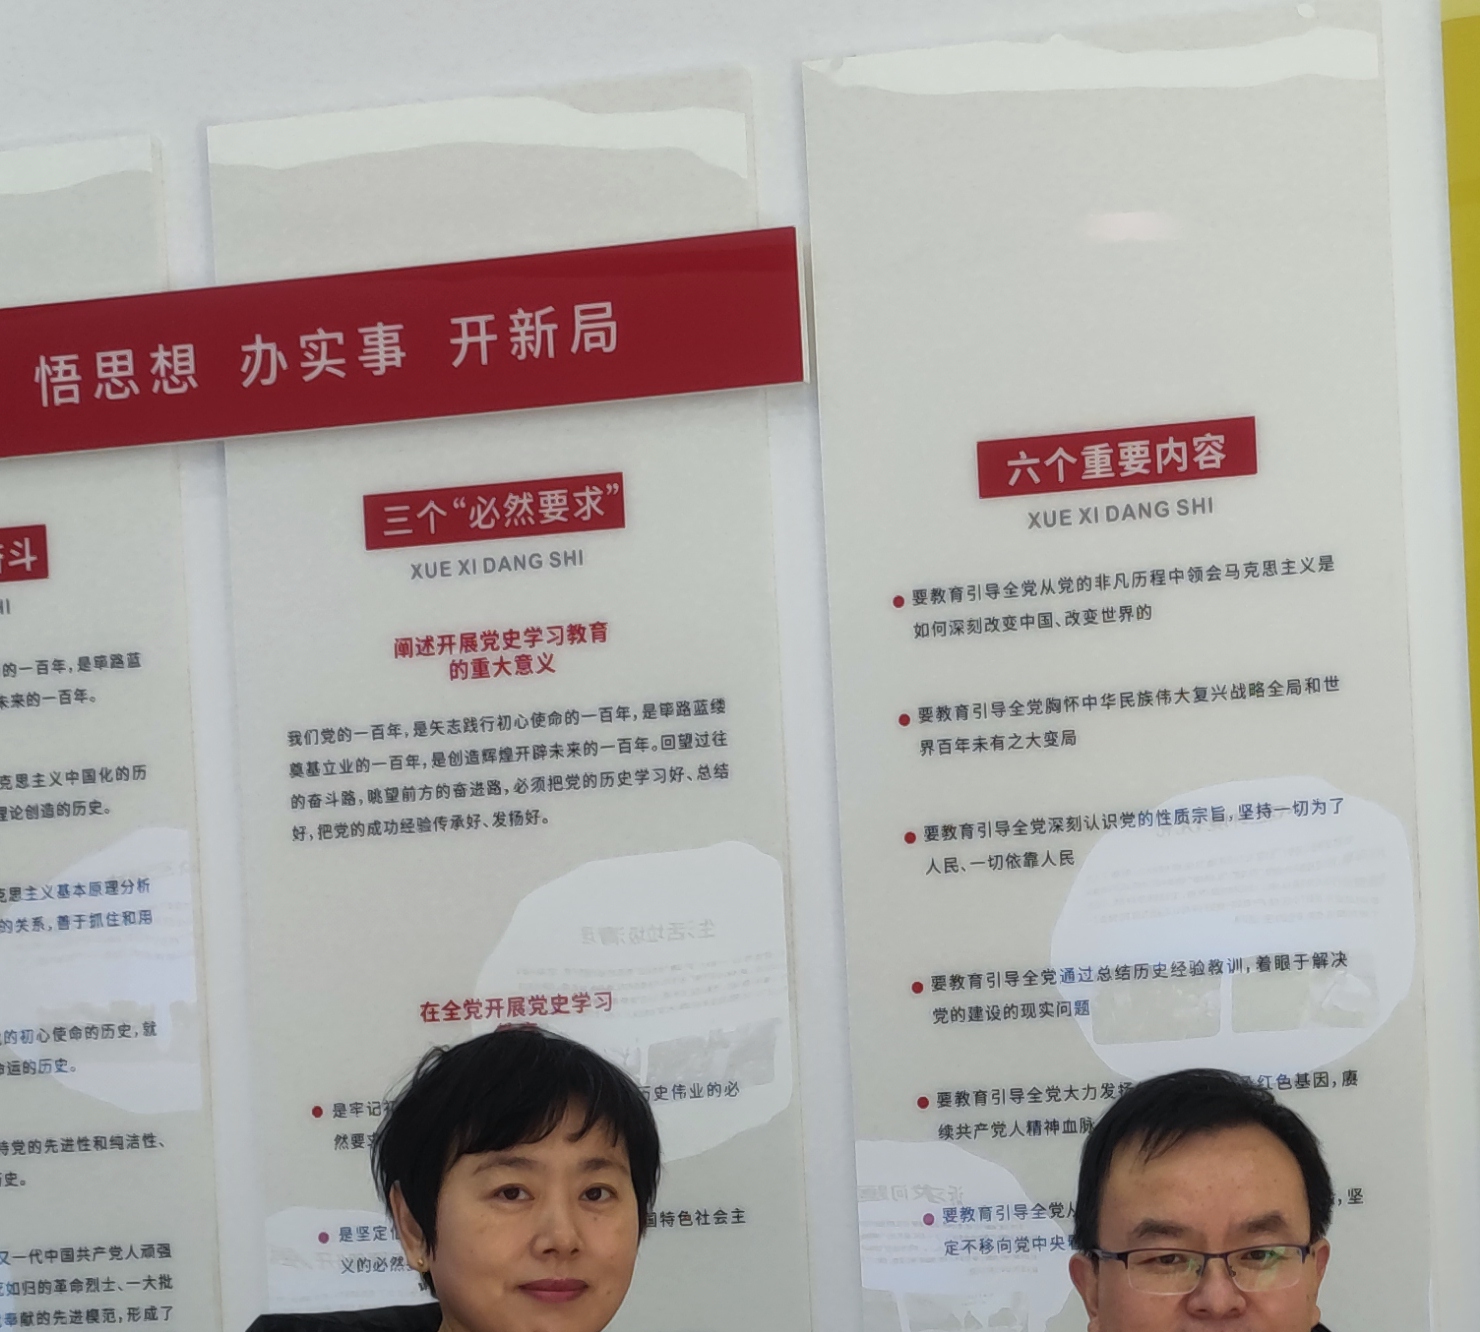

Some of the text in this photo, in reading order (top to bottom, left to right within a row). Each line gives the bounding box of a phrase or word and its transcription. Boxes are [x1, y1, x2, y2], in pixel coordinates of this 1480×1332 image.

[34, 343, 200, 405] 悟思想
[239, 319, 409, 386] 办实事
[449, 298, 622, 370] 开新局
[1007, 433, 1226, 486] 六个重要内容
[383, 482, 620, 535] 三个“必然要求”
[1028, 497, 1213, 529] XUE XI DANG SHI
[410, 549, 584, 580] XUE XI DANG SHI
[912, 555, 1334, 606] 要教育引导全党从党的非凡历程中领会马克思主义是
[914, 604, 1152, 639] 如何深刻改变中国、改变世界的
[393, 621, 608, 659] 阐述开展党史学习教育
[449, 652, 556, 681] 的重大意义
[918, 675, 1339, 724] 要教育引导全党胸怀中华民族伟大复兴战略全局和世
[920, 730, 1076, 756] 界百年未有之大变局
[924, 798, 1343, 842] 要教育引导全党深刻认识党的性质宗旨，坚持一切为了
[926, 850, 1074, 875] 人民、一切依靠人民
[420, 992, 612, 1022] 在全党开展党史学习
[933, 1000, 1089, 1024] 党的建设的现实问题
[341, 1255, 413, 1275] 义的必然
